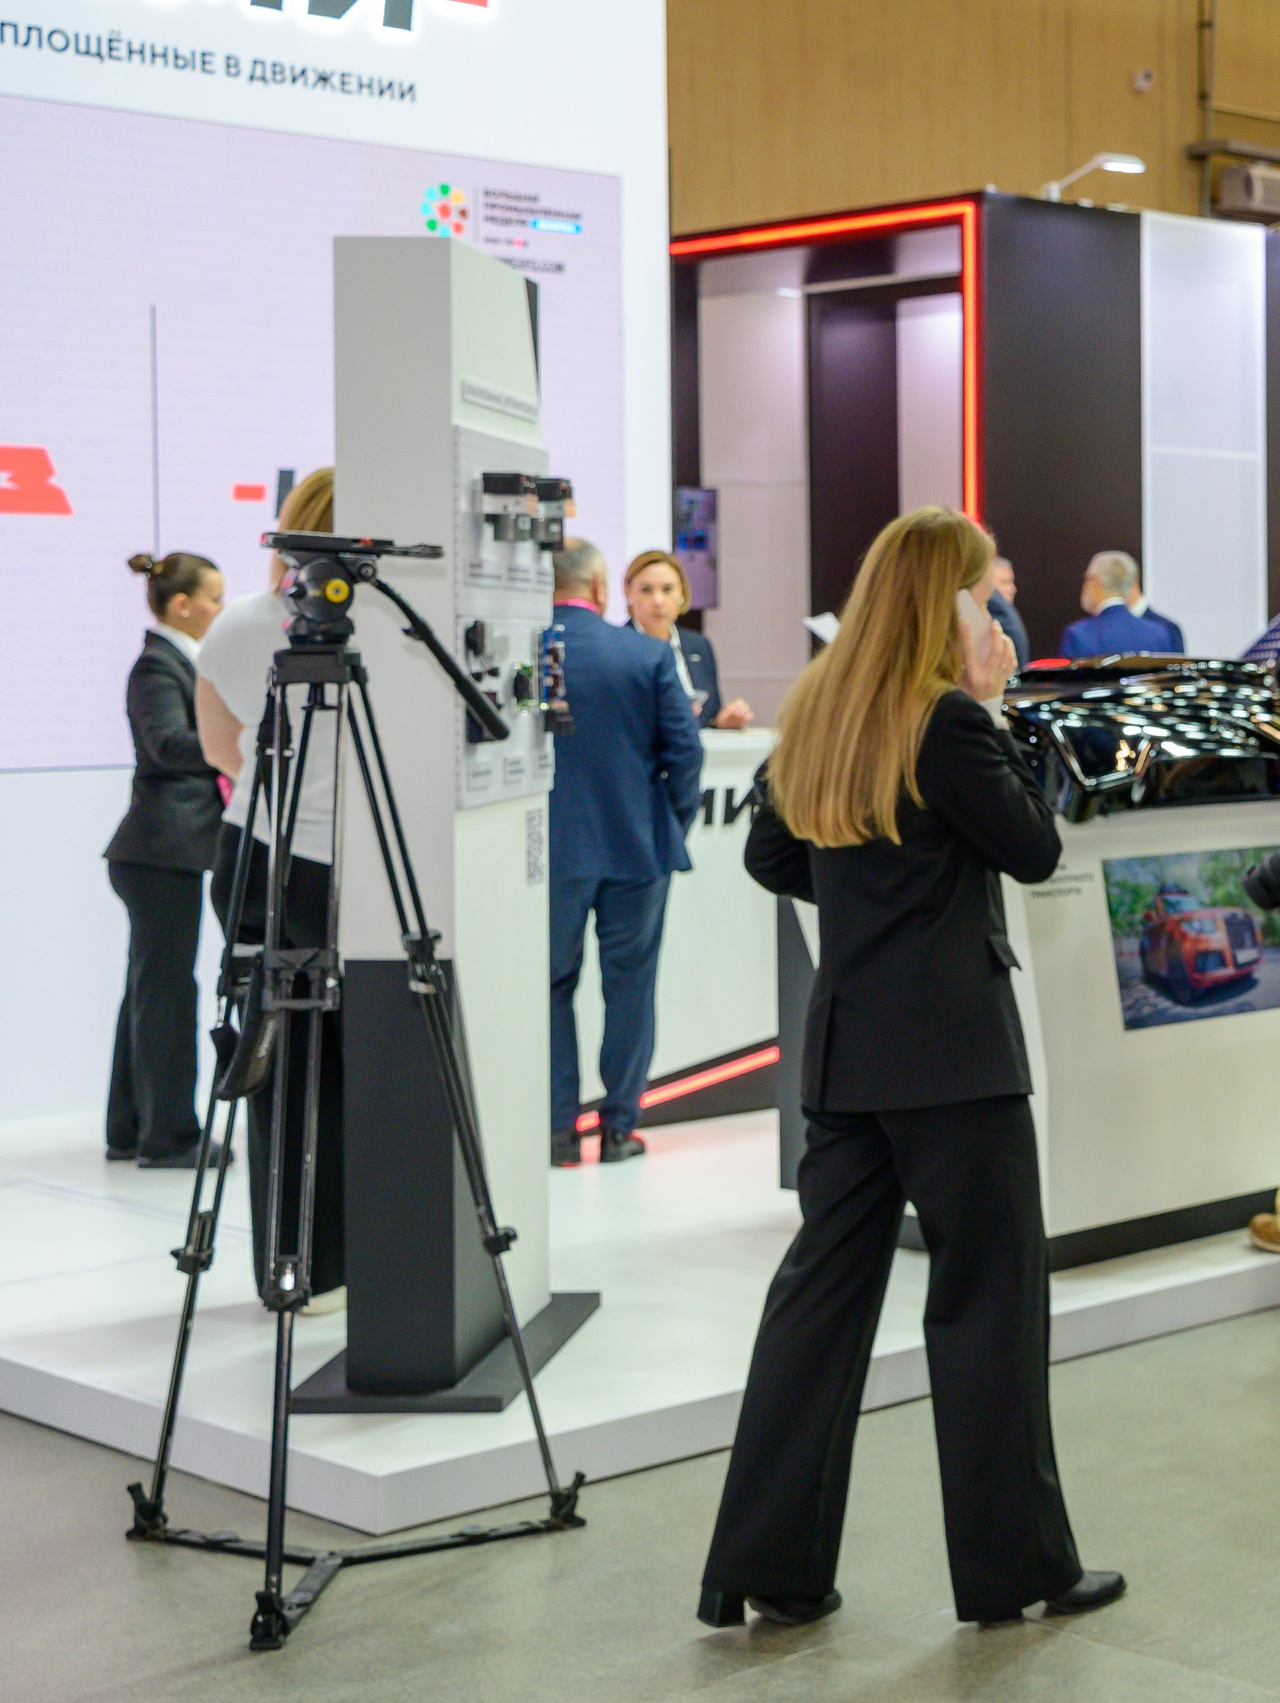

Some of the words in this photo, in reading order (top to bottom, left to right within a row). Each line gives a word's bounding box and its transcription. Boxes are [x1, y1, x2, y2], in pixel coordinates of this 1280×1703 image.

[0, 20, 217, 75] ПЛОЩЁННЫЕ
[224, 54, 242, 78] В
[248, 57, 417, 104] ДВИЖЕНИИ
